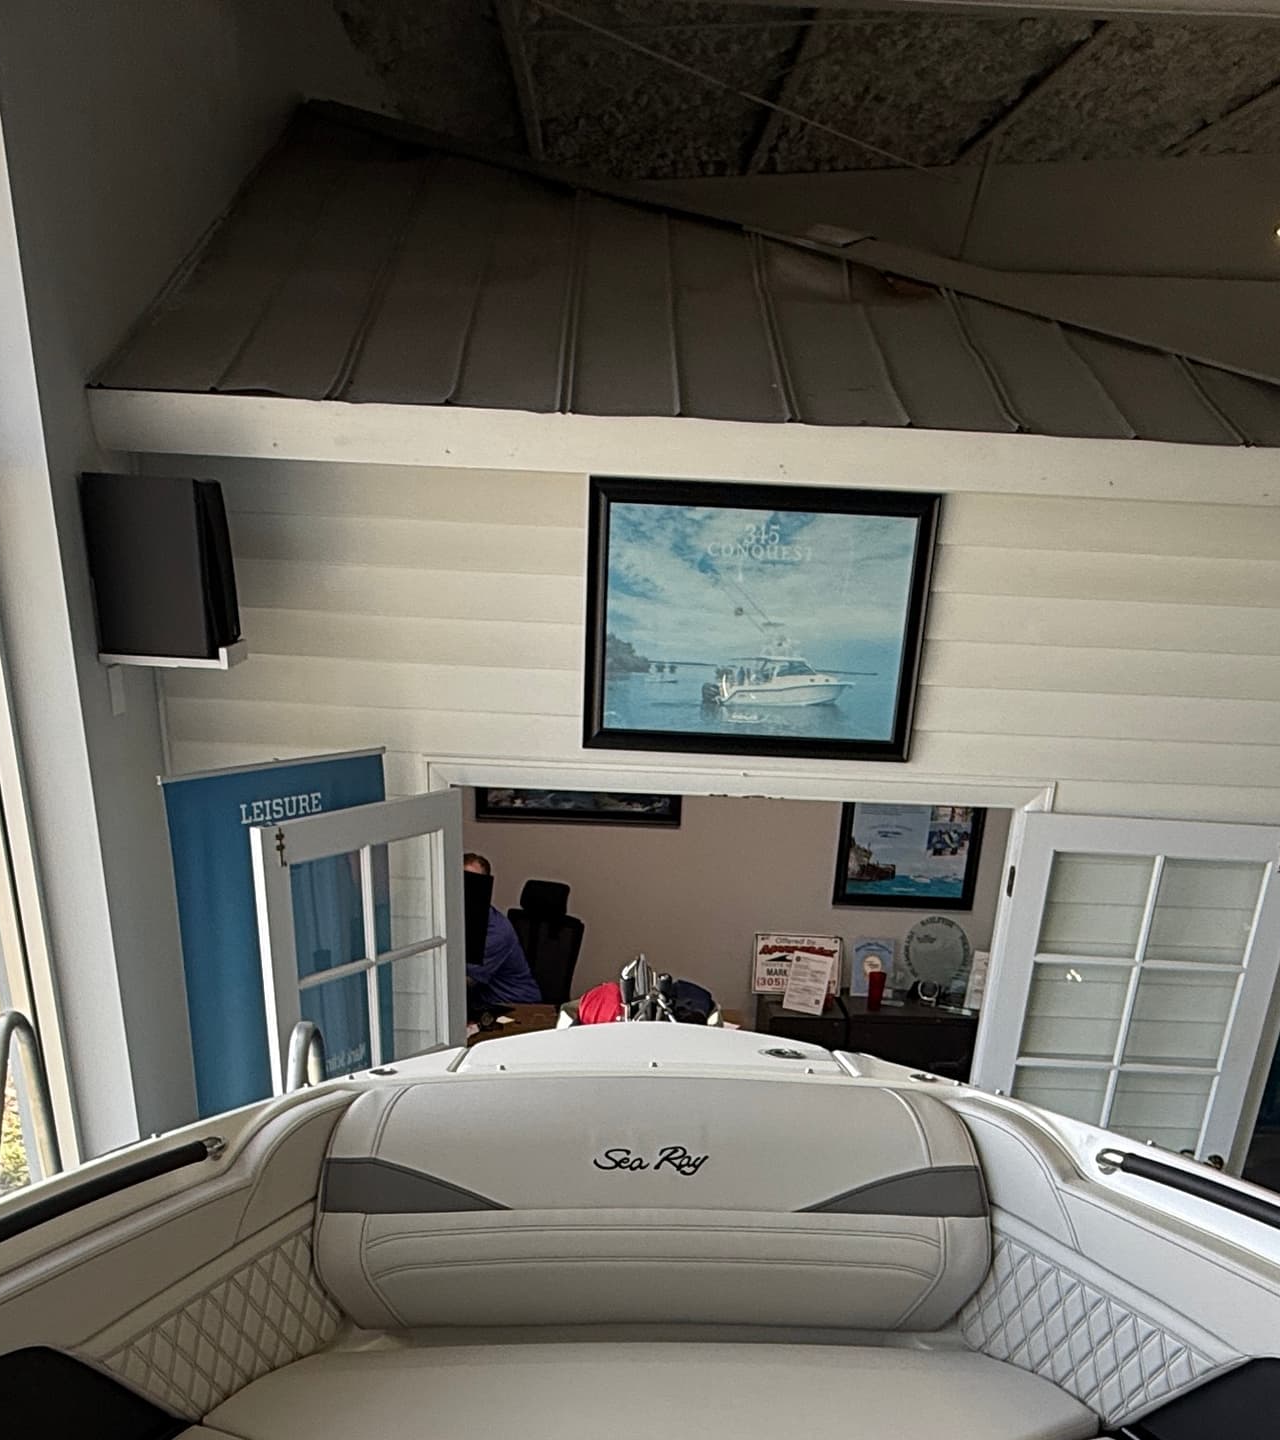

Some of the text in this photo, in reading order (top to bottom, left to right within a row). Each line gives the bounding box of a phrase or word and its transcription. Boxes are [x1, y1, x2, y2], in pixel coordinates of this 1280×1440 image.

[707, 542, 812, 561] CONQUEST
[239, 792, 322, 825] LEISURE
[593, 1145, 709, 1176] Sea Ray
